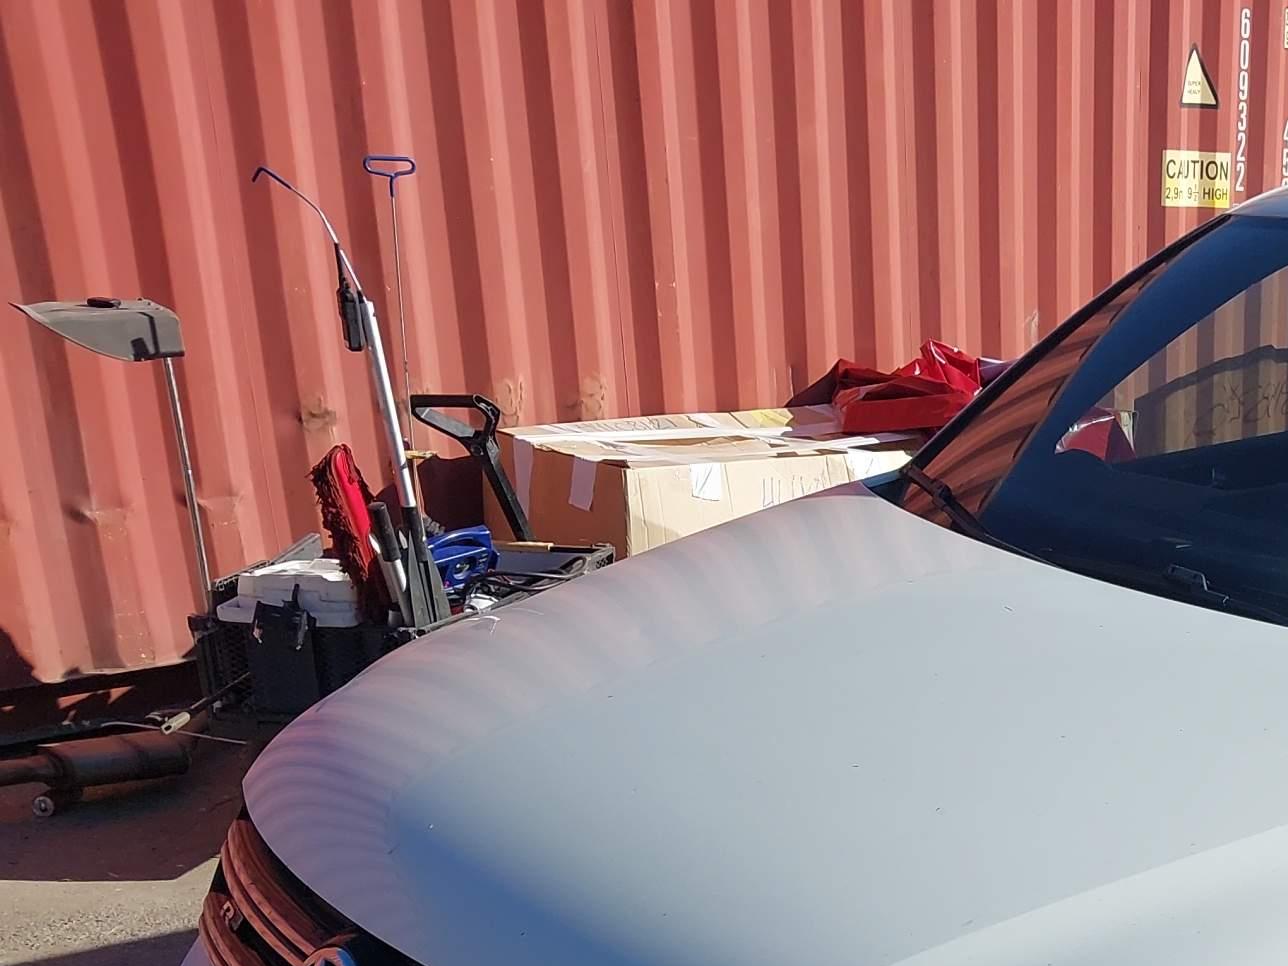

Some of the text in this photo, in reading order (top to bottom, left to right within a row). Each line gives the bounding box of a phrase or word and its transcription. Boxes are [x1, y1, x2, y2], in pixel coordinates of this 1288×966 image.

[1235, 8, 1251, 192] 609322
[1166, 159, 1229, 181] CAUTION
[1203, 187, 1228, 201] HIGH
